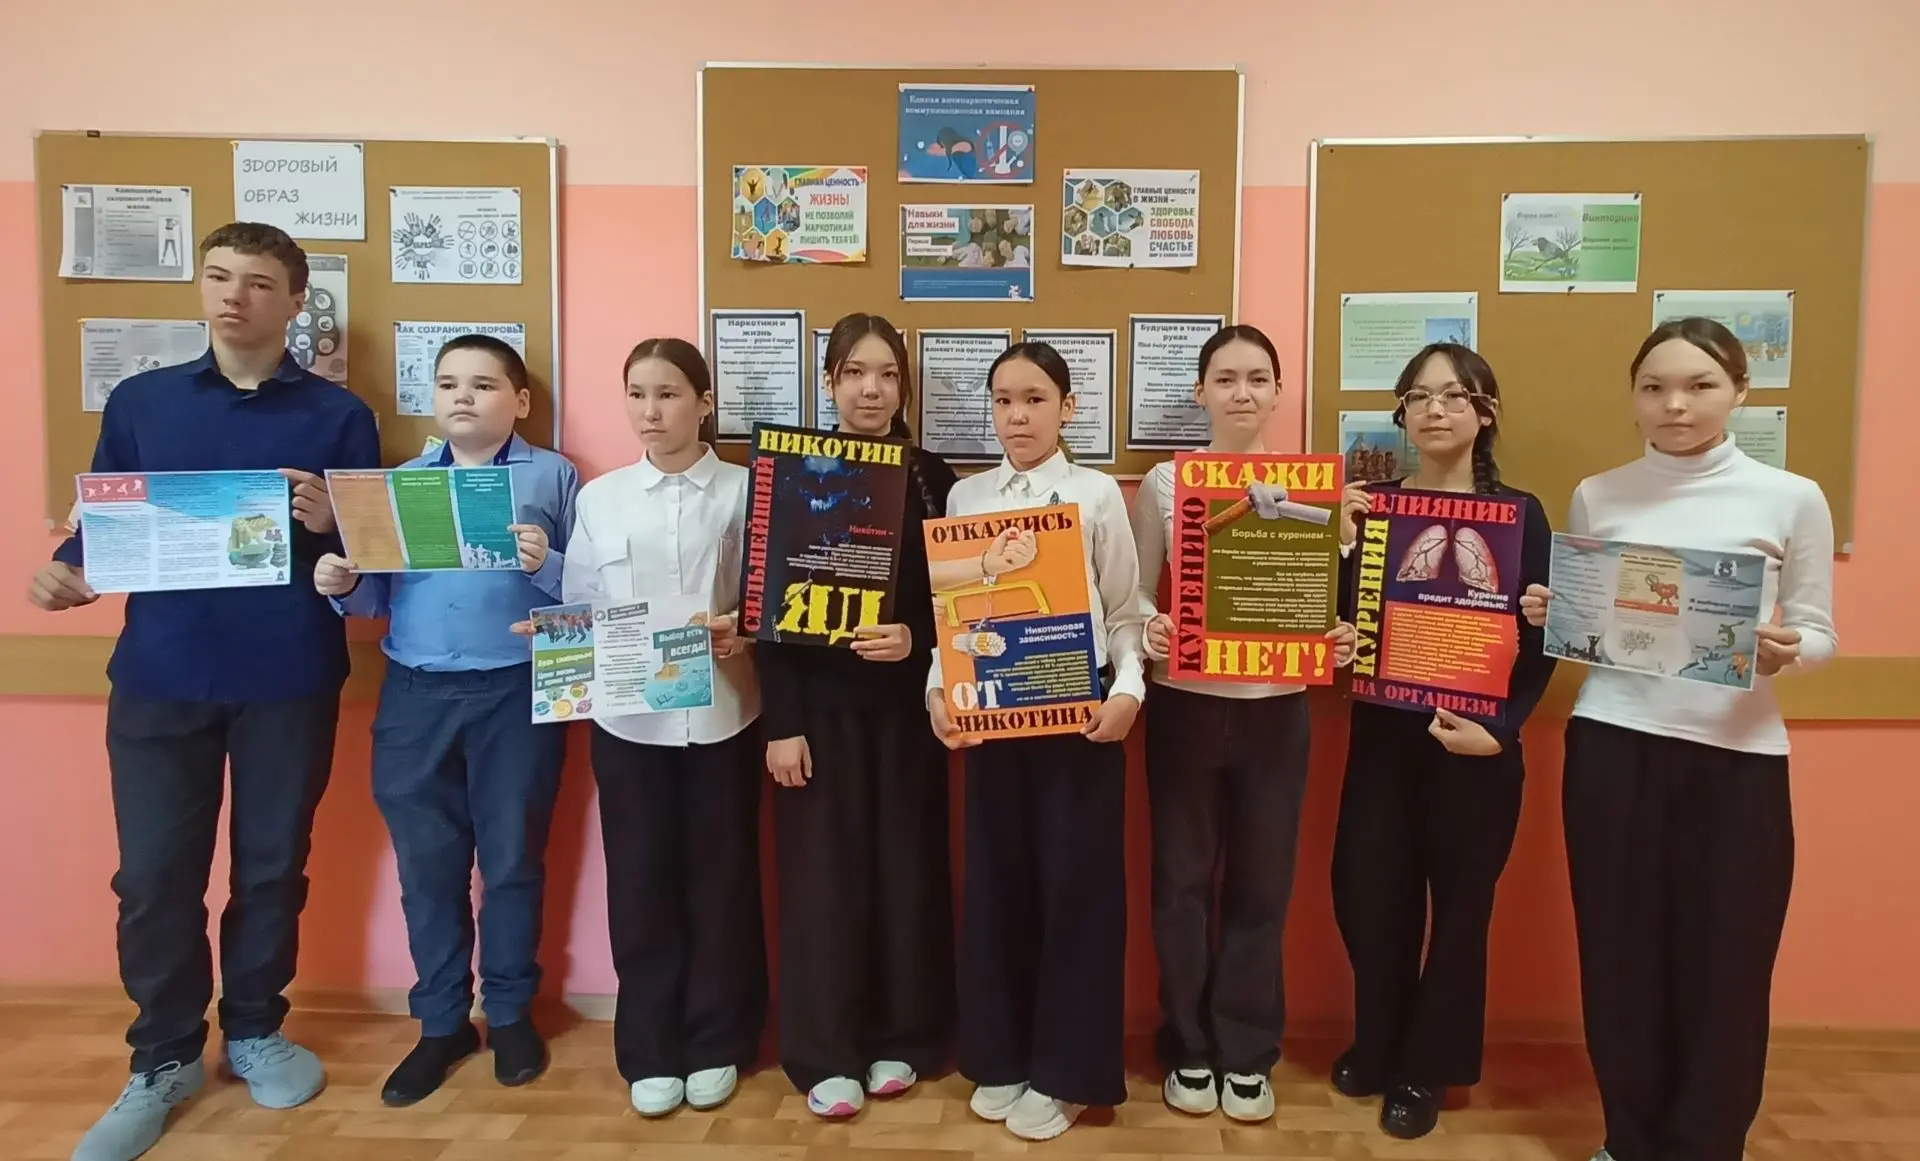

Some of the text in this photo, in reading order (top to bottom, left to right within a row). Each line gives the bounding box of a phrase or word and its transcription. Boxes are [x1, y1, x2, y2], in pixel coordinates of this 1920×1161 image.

[242, 155, 338, 173] ЗДОРОВЫЙ
[243, 188, 300, 203] ОБРАЗ
[1140, 195, 1169, 204] ЖИЗНИ
[294, 210, 359, 227] ЖИЗНИ
[907, 209, 944, 218] Навыки
[1150, 206, 1195, 217] ЗДОРОВЬЕ
[804, 223, 855, 232] НАРКОТИКАМ
[926, 221, 956, 229] жизни
[1149, 218, 1195, 229] СВОБОДА
[1149, 230, 1194, 240] ЛЮБОВЬ
[1148, 241, 1194, 251] СЧАСТЬЕ
[417, 325, 472, 334] СОХРАНИТЬ
[727, 319, 778, 328] Наркотики
[1140, 324, 1178, 332] Будущее
[758, 429, 903, 466] НИКОТИН
[1181, 460, 1336, 491] СКАЖИ
[1369, 492, 1517, 524] ВЛИЯНИЕ
[848, 525, 889, 537] Никотин
[931, 511, 1073, 544] ОТКАЖИСЬ
[1231, 528, 1267, 539] Борьба
[1278, 531, 1324, 540] курением
[744, 456, 775, 632] СИЛЬНЕЙШИЙ
[1178, 496, 1206, 673] КУРЕНИЮ
[1353, 518, 1390, 677] КУРЕНИЯ
[1418, 593, 1508, 610] вредит здоровью:
[1467, 589, 1509, 601] Курение
[775, 582, 886, 645] ЯД
[658, 628, 704, 643] Выбор есть
[1024, 621, 1085, 635] Никотиновая
[1018, 631, 1078, 645] зависимость
[670, 641, 708, 658] всегда!
[1204, 638, 1327, 678] НЕТ!
[952, 679, 1003, 711] ОТ
[1351, 678, 1497, 717] НА ОРГАНИЗМ
[954, 706, 1093, 733] НИКОТИНА
